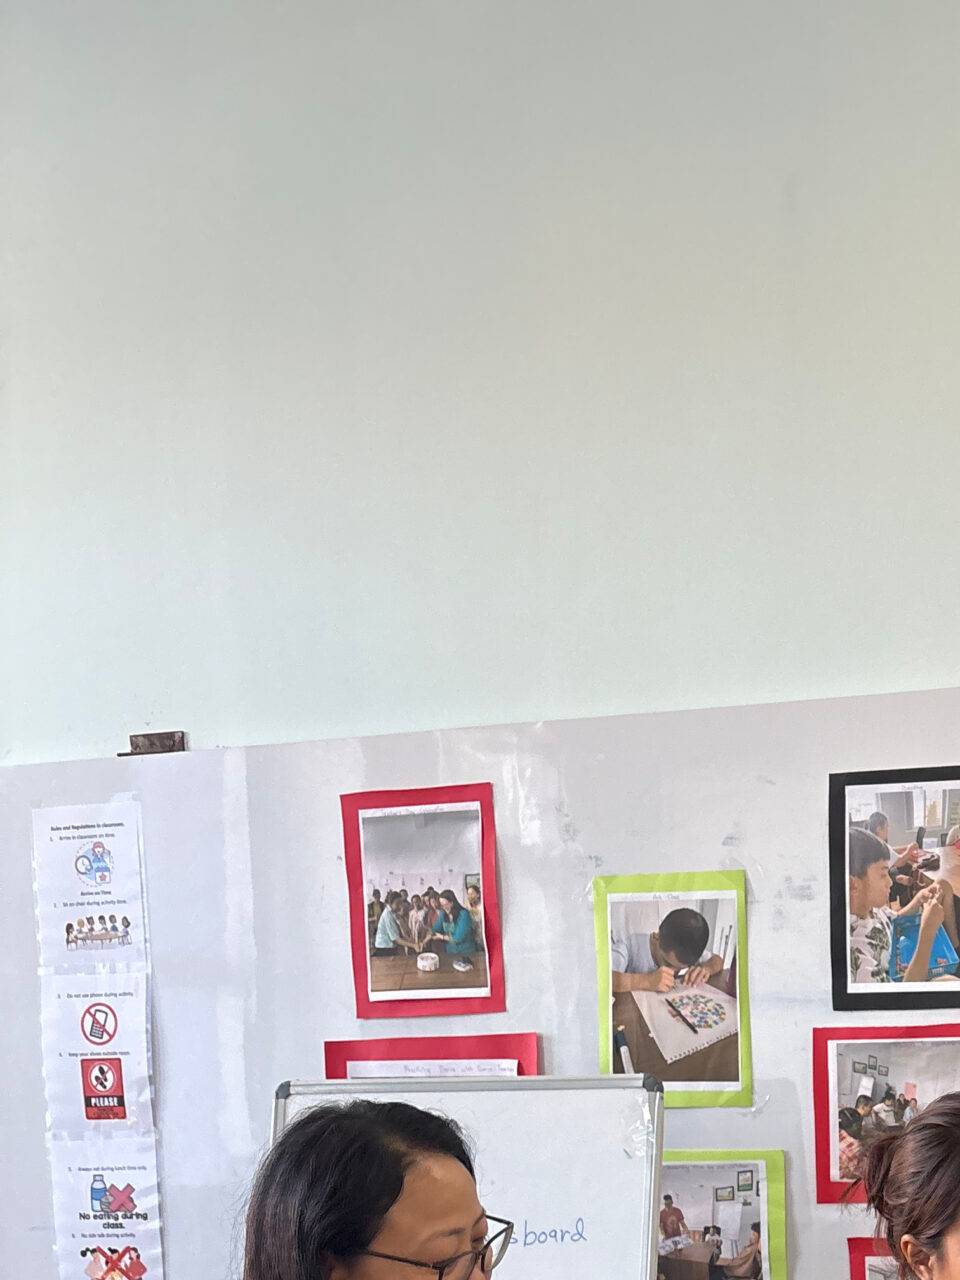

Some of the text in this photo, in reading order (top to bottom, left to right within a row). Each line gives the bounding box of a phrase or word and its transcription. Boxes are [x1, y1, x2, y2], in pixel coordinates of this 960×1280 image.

[90, 1096, 119, 1107] PLEASE
[79, 1211, 148, 1221] No eating during
